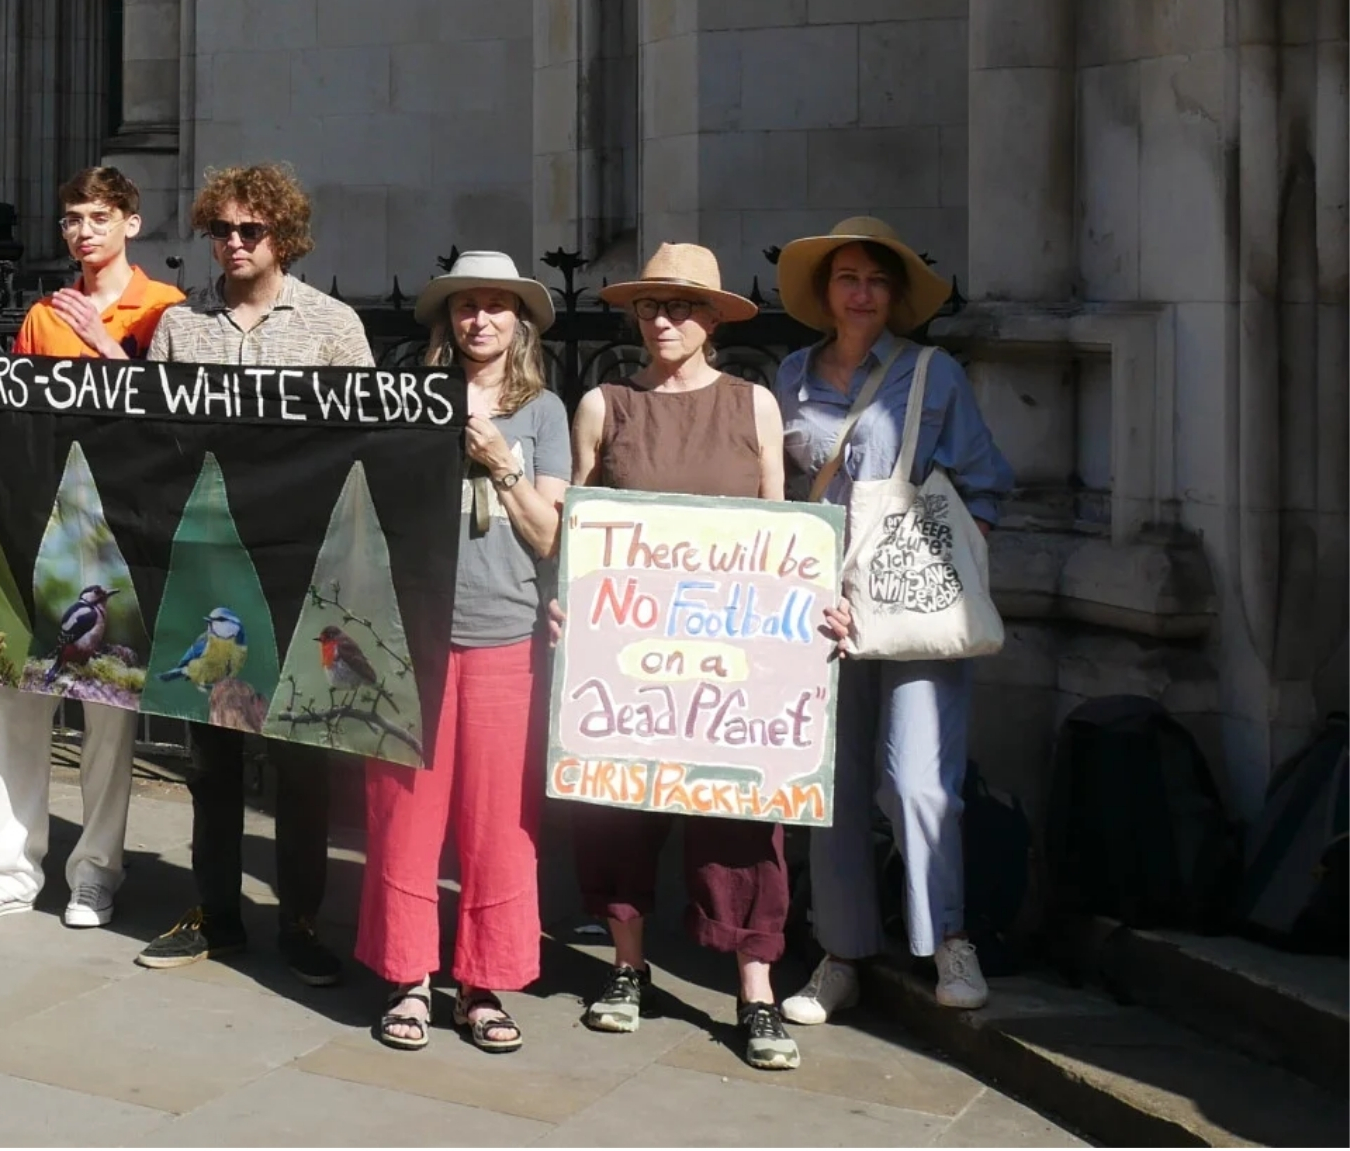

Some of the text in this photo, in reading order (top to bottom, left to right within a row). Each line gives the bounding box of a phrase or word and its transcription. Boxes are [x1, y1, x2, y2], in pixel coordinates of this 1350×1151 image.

[708, 529, 771, 573] will
[777, 533, 821, 581] be
[666, 580, 814, 644] Football
[639, 650, 728, 677] on a
[571, 678, 677, 737] dead
[553, 758, 825, 819] CHRIS PACKHAM
